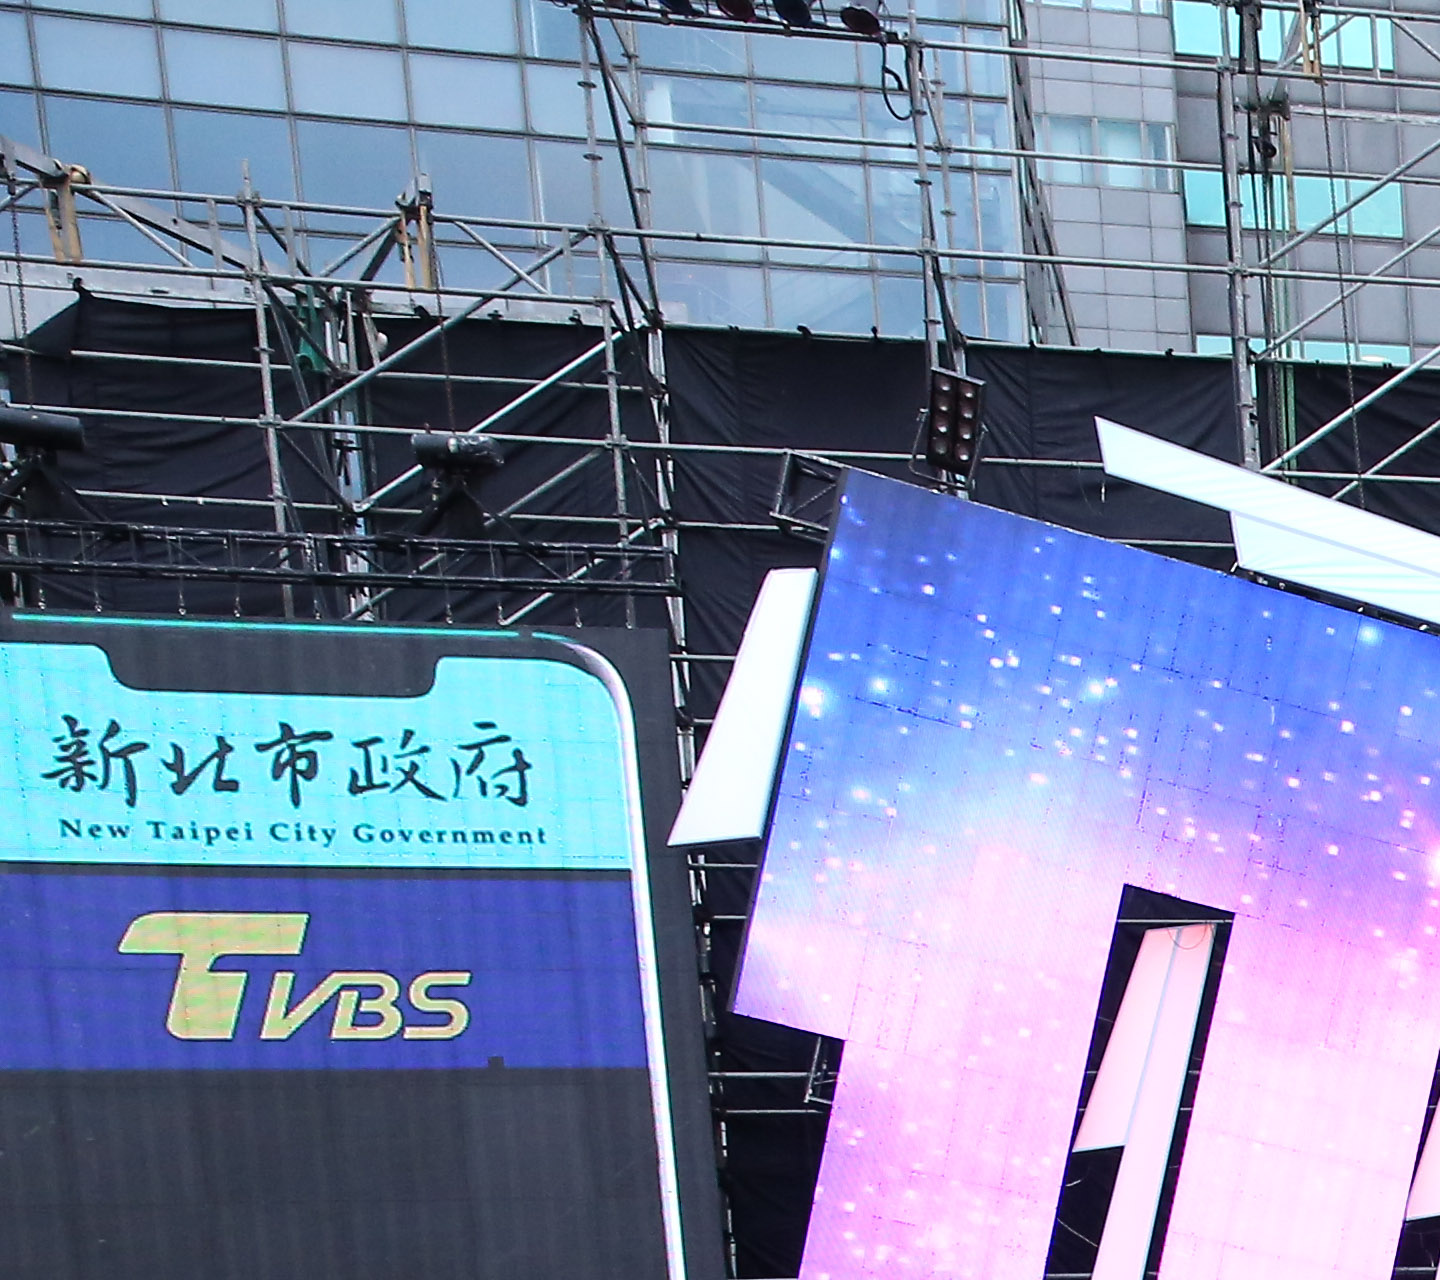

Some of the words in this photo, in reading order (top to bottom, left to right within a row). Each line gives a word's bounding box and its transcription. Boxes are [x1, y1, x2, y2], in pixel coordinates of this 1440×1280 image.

[41, 714, 532, 808] 新北市政府
[59, 817, 130, 842] New
[150, 819, 254, 846] Taipei
[270, 822, 337, 848] City
[354, 822, 548, 846] Government
[117, 910, 471, 1042] TVBS
